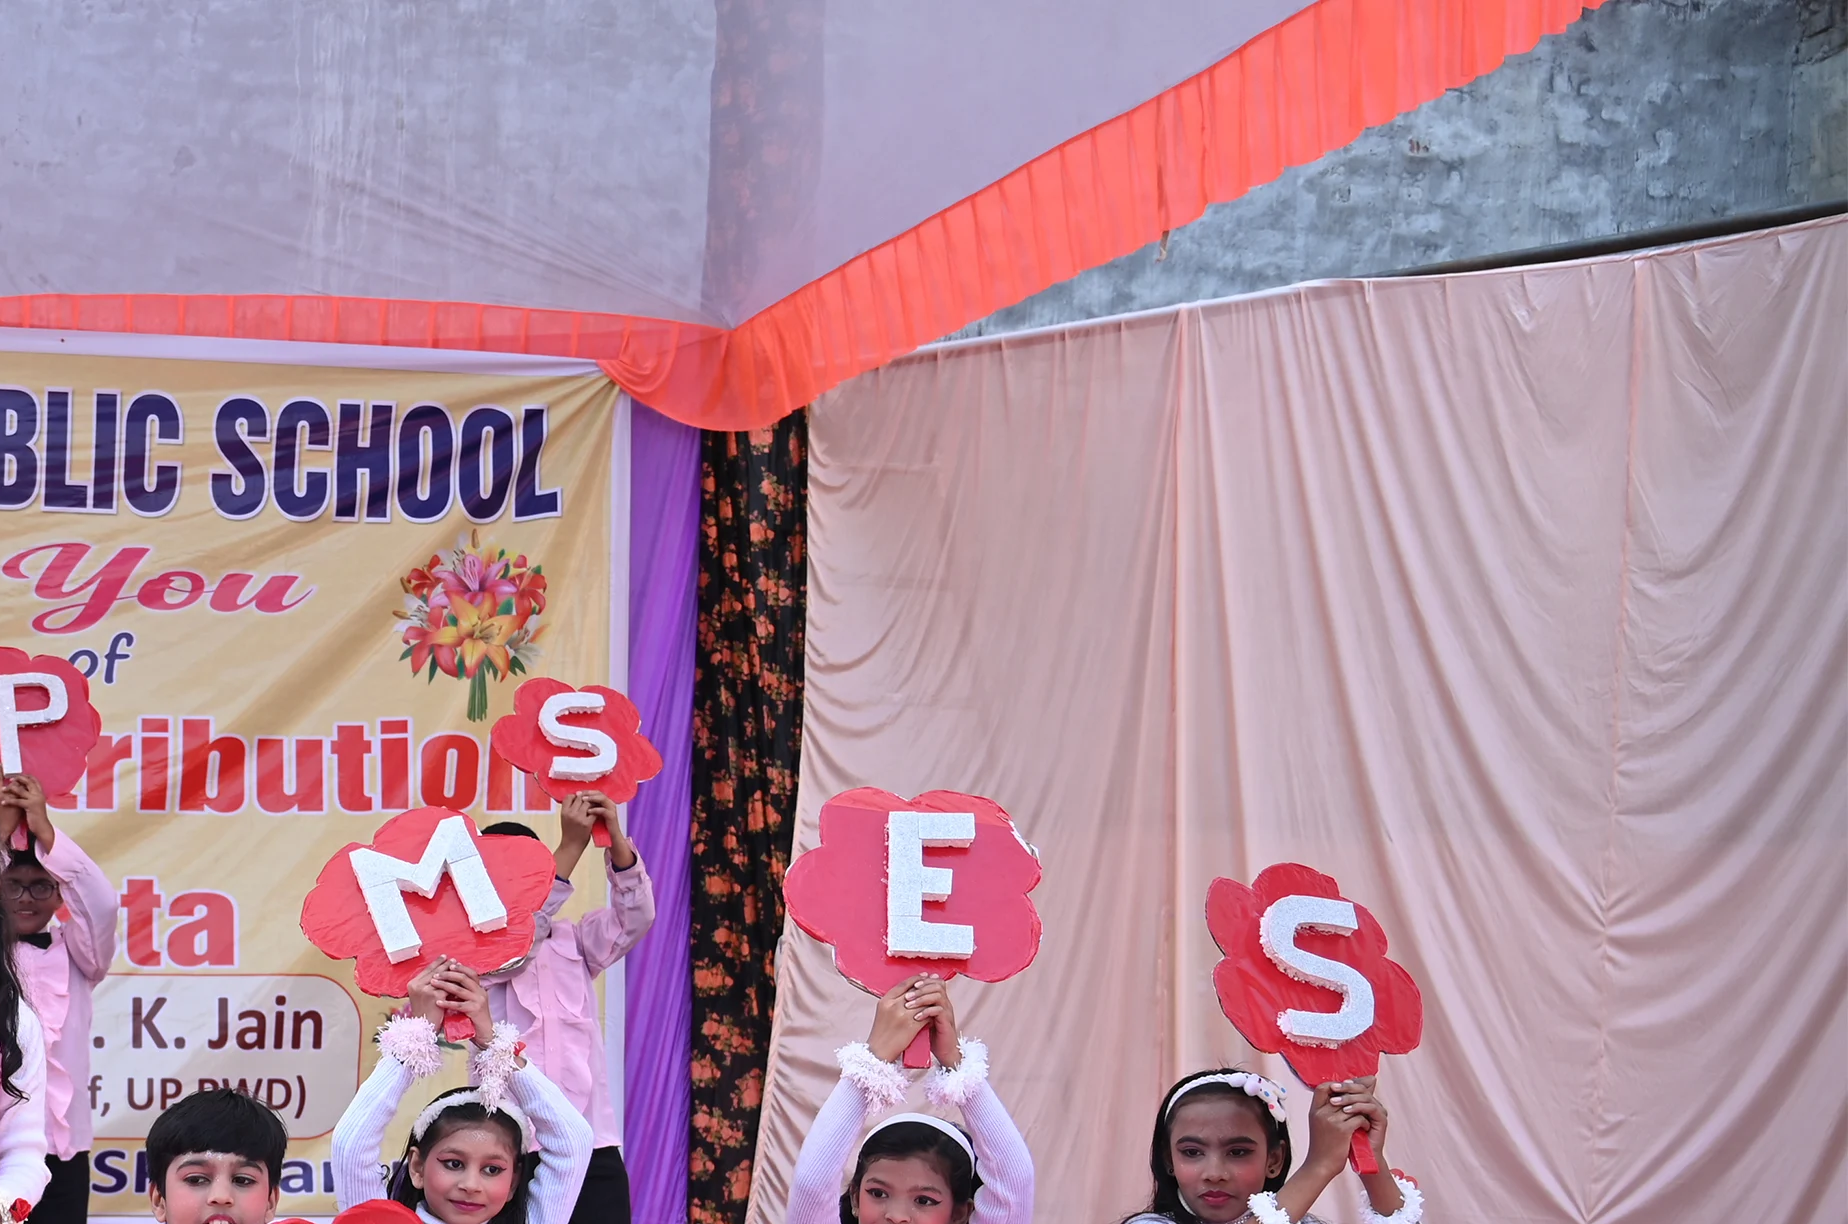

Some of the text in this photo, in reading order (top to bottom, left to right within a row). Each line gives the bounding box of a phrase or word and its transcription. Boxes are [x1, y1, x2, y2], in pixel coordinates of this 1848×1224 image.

[210, 398, 559, 519] SCHOOL
[2, 542, 312, 634] You
[69, 632, 135, 684] of
[538, 692, 618, 782] S
[349, 815, 508, 965] M
[886, 811, 976, 960] E
[1259, 894, 1375, 1049] S
[131, 996, 186, 1050] K.
[207, 994, 324, 1051] Jain
[127, 1077, 183, 1111] UP
